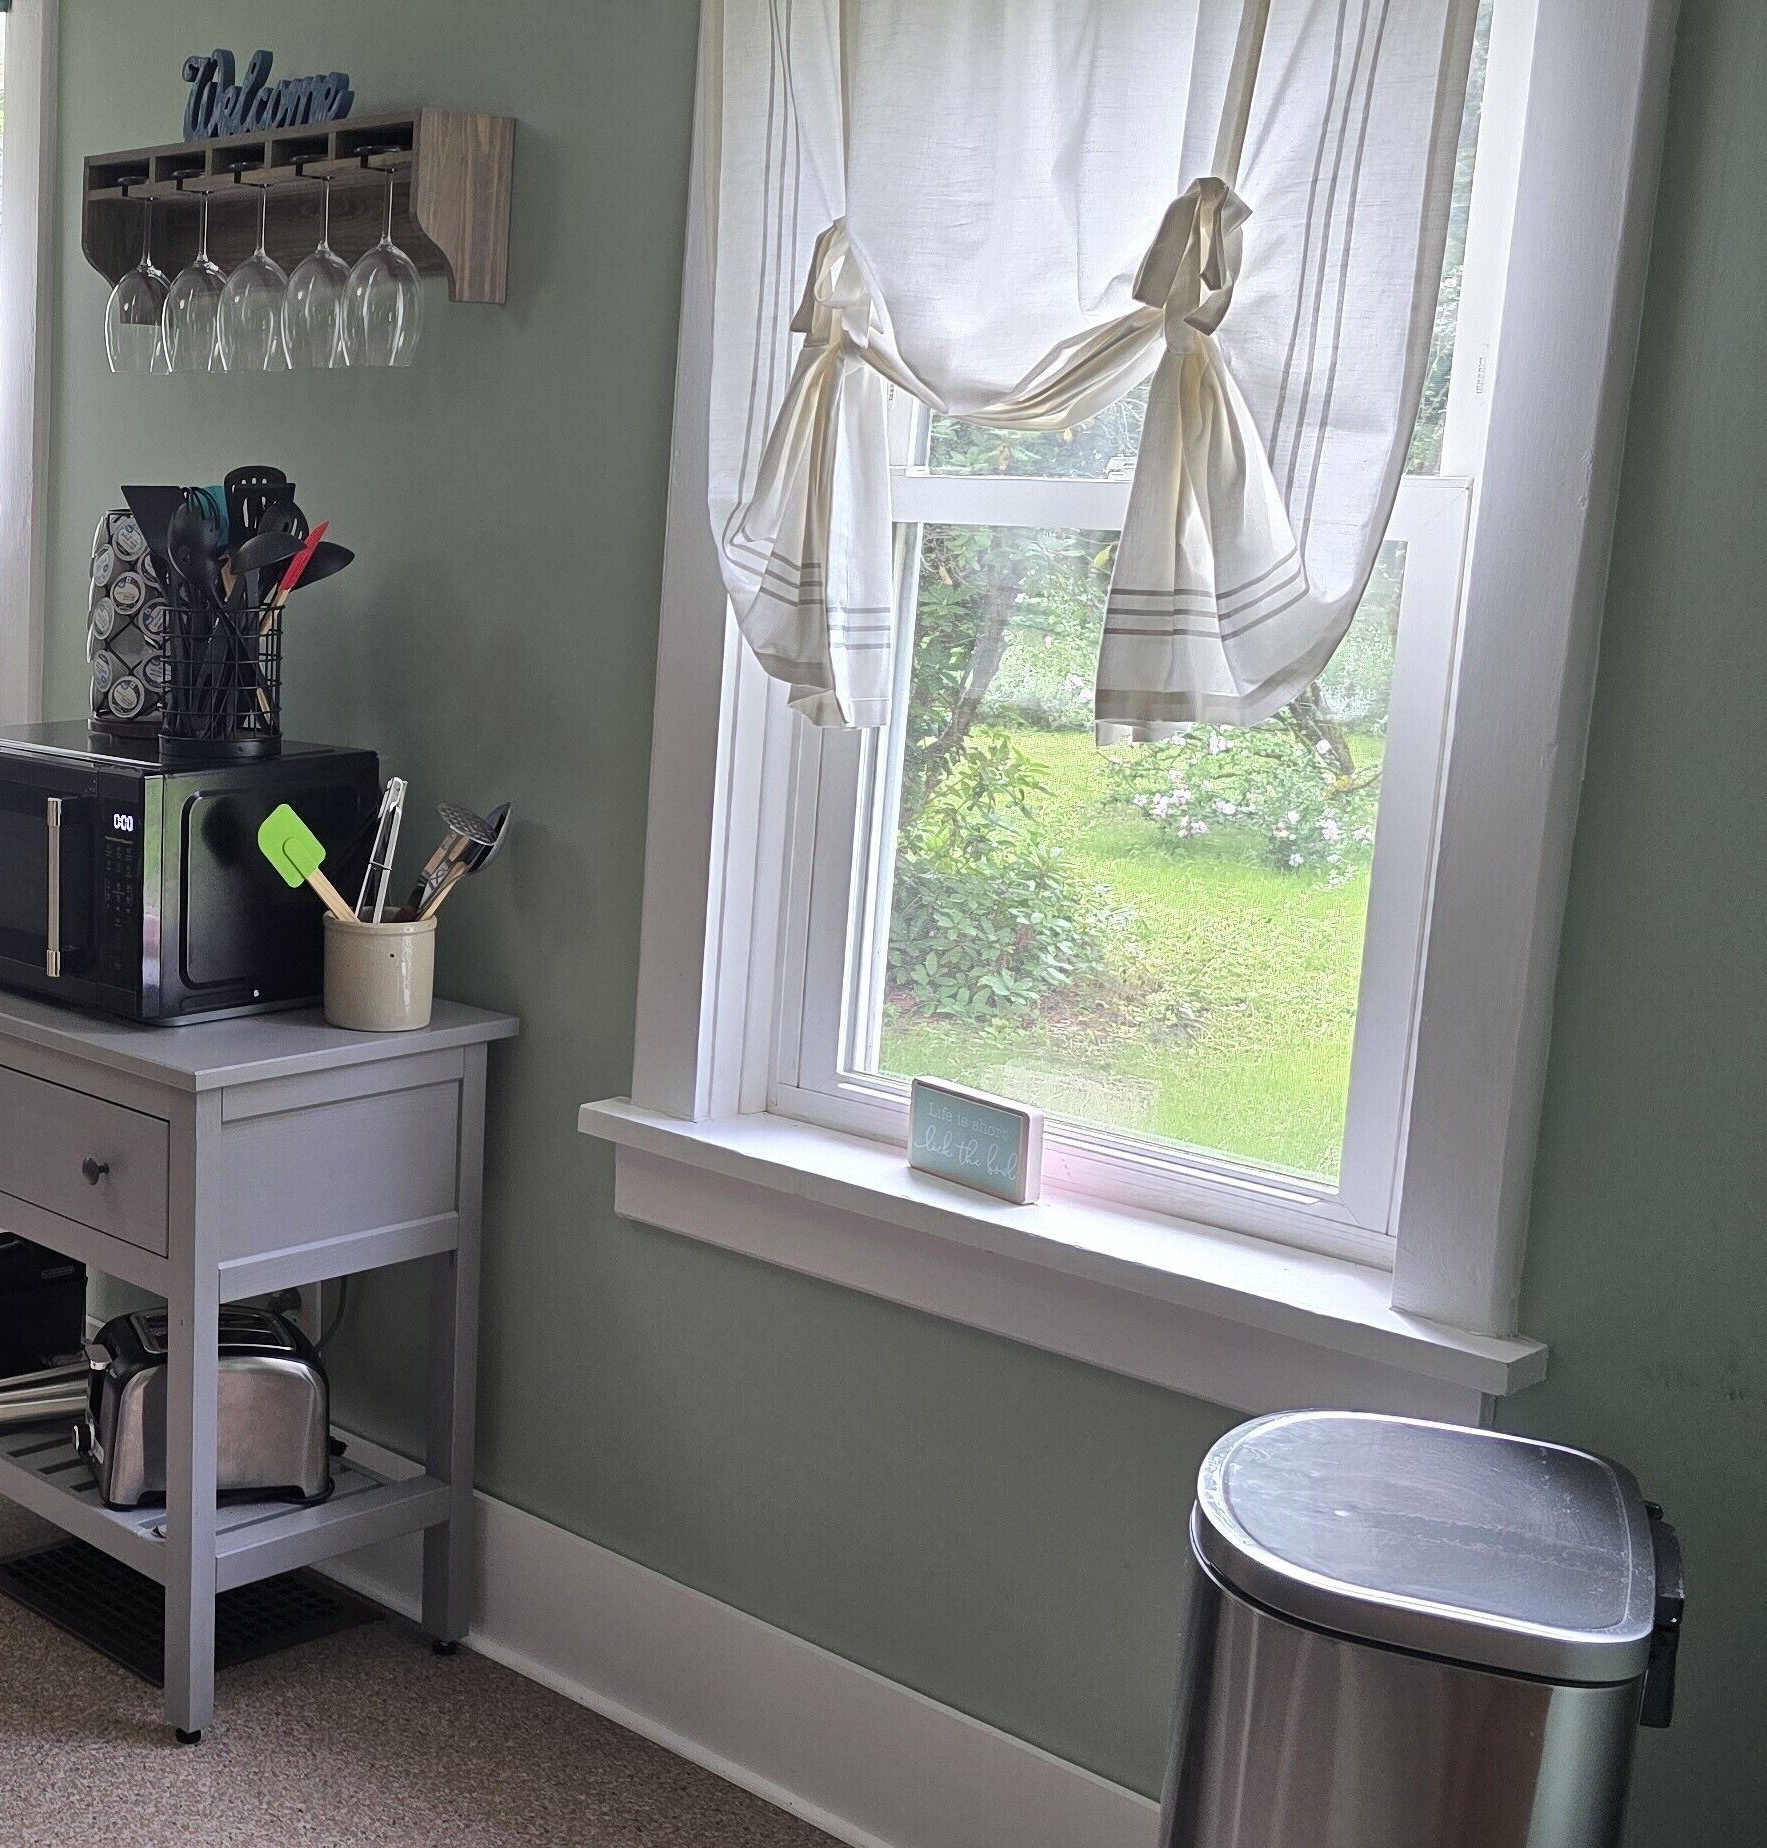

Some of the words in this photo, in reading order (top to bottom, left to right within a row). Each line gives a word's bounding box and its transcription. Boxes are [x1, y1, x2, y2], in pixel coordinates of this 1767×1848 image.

[182, 49, 355, 140] Welcome
[928, 1102, 953, 1122] Life
[956, 1114, 969, 1127] is
[914, 1125, 954, 1157] lick
[954, 1139, 981, 1166] the
